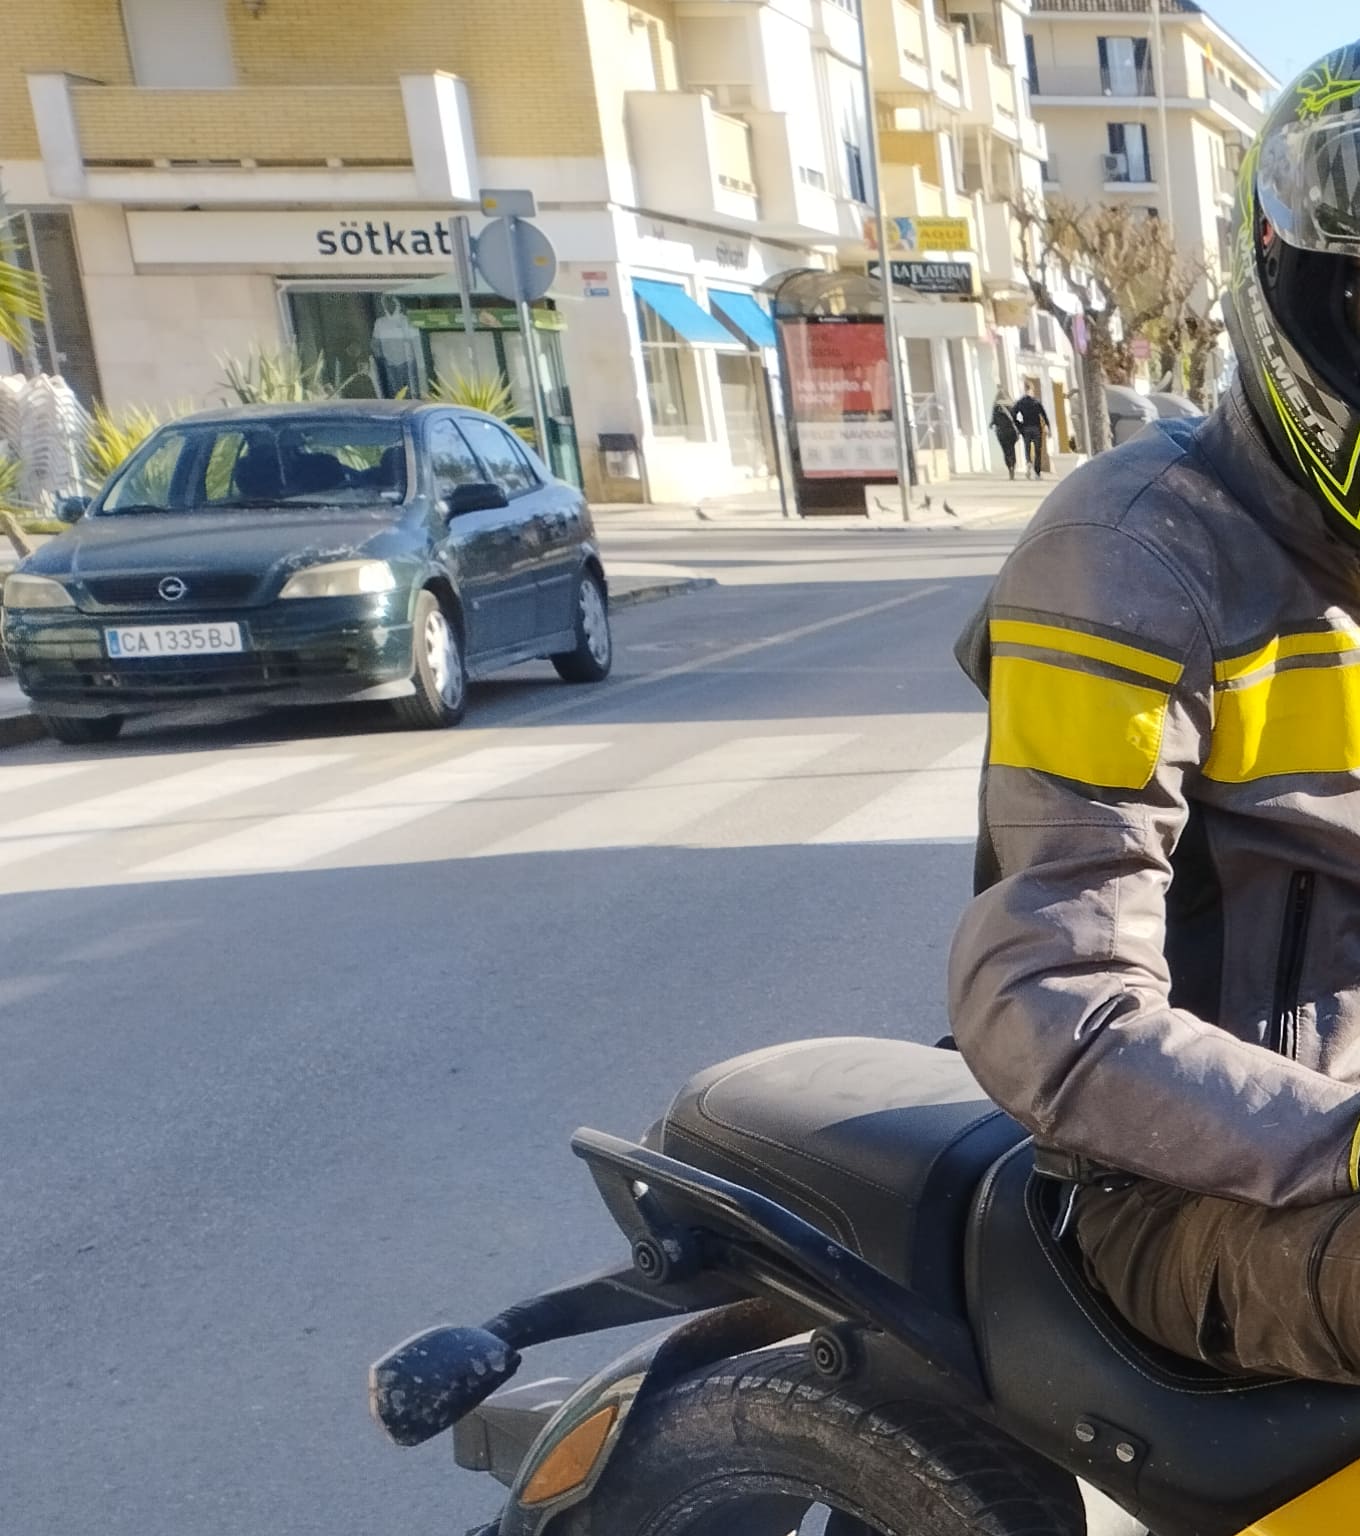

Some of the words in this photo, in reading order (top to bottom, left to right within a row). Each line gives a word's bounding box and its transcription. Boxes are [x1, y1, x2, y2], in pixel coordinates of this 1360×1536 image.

[892, 264, 910, 278] LA
[1247, 285, 1341, 453] HELMETS
[121, 631, 149, 652] CA
[154, 629, 205, 652] 1335
[208, 626, 236, 649] BJ
